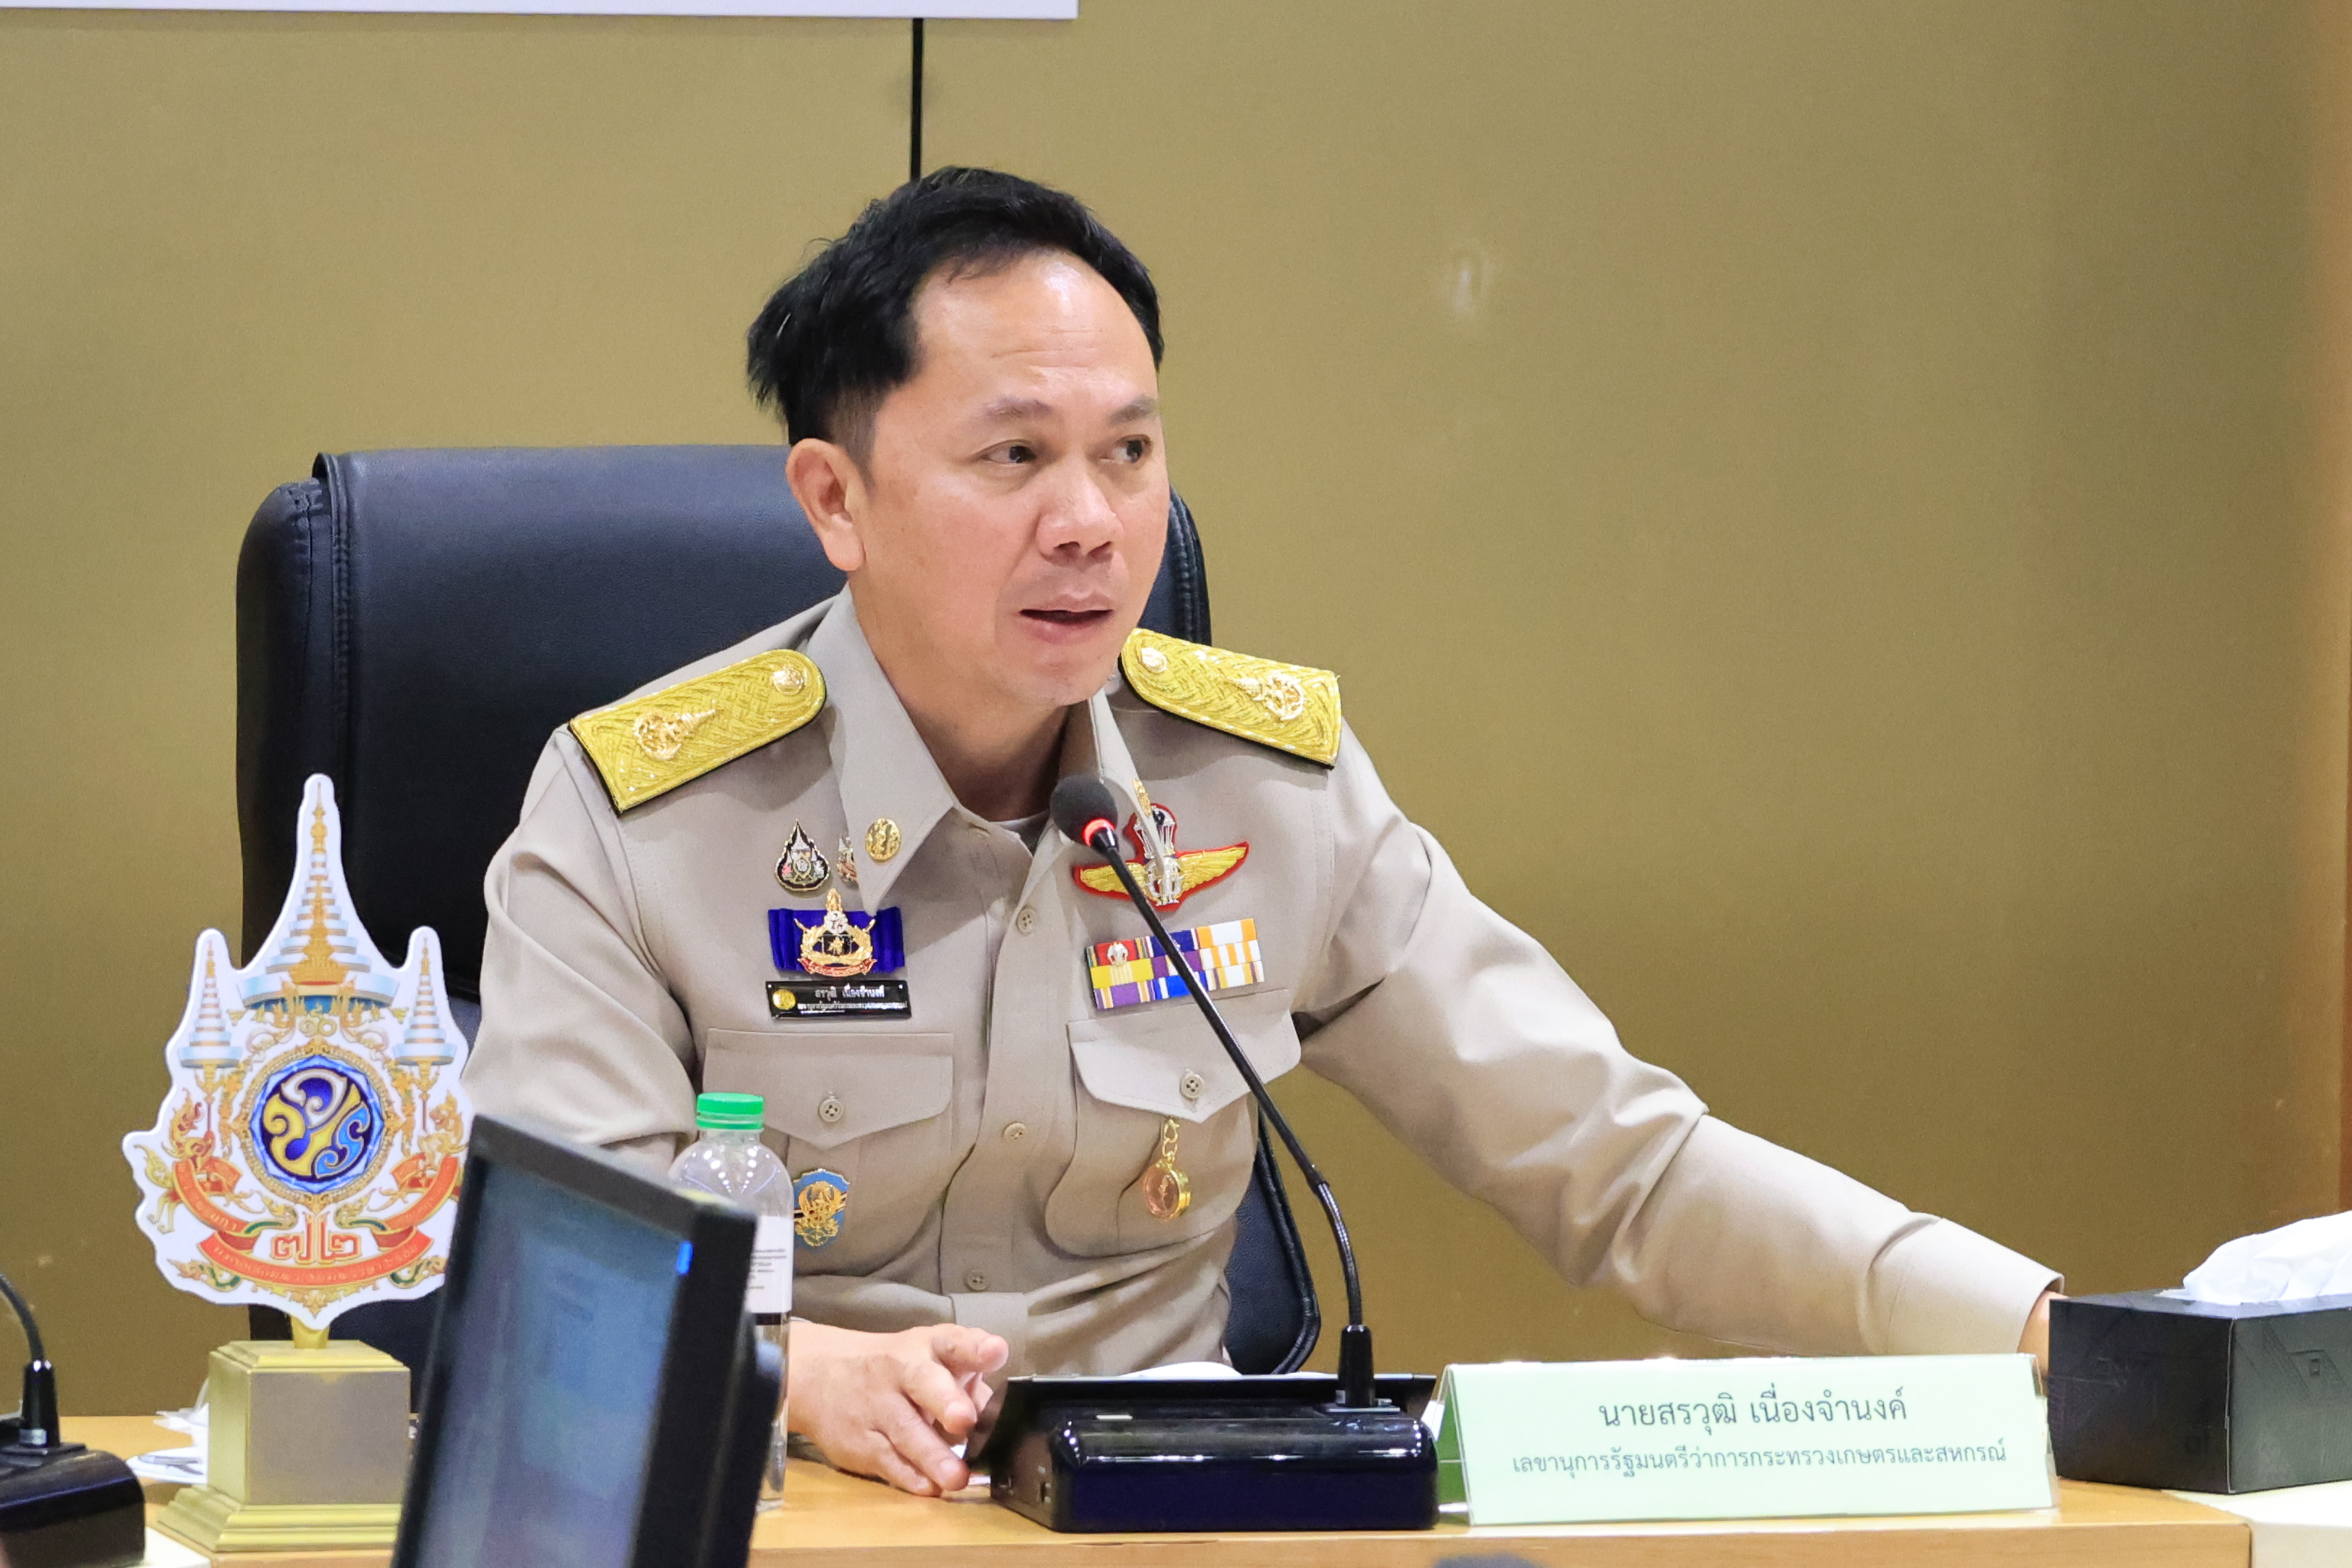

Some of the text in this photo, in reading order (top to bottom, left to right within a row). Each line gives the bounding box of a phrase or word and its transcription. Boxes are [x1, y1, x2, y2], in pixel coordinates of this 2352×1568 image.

[1598, 1382, 1907, 1436] นายสรวุฒิ เนื่องจำนงค์
[1513, 1437, 2007, 1479] เลขานุการรัฐมนตรีว่าการกระทรวงเกษตรและสหกรณ์
